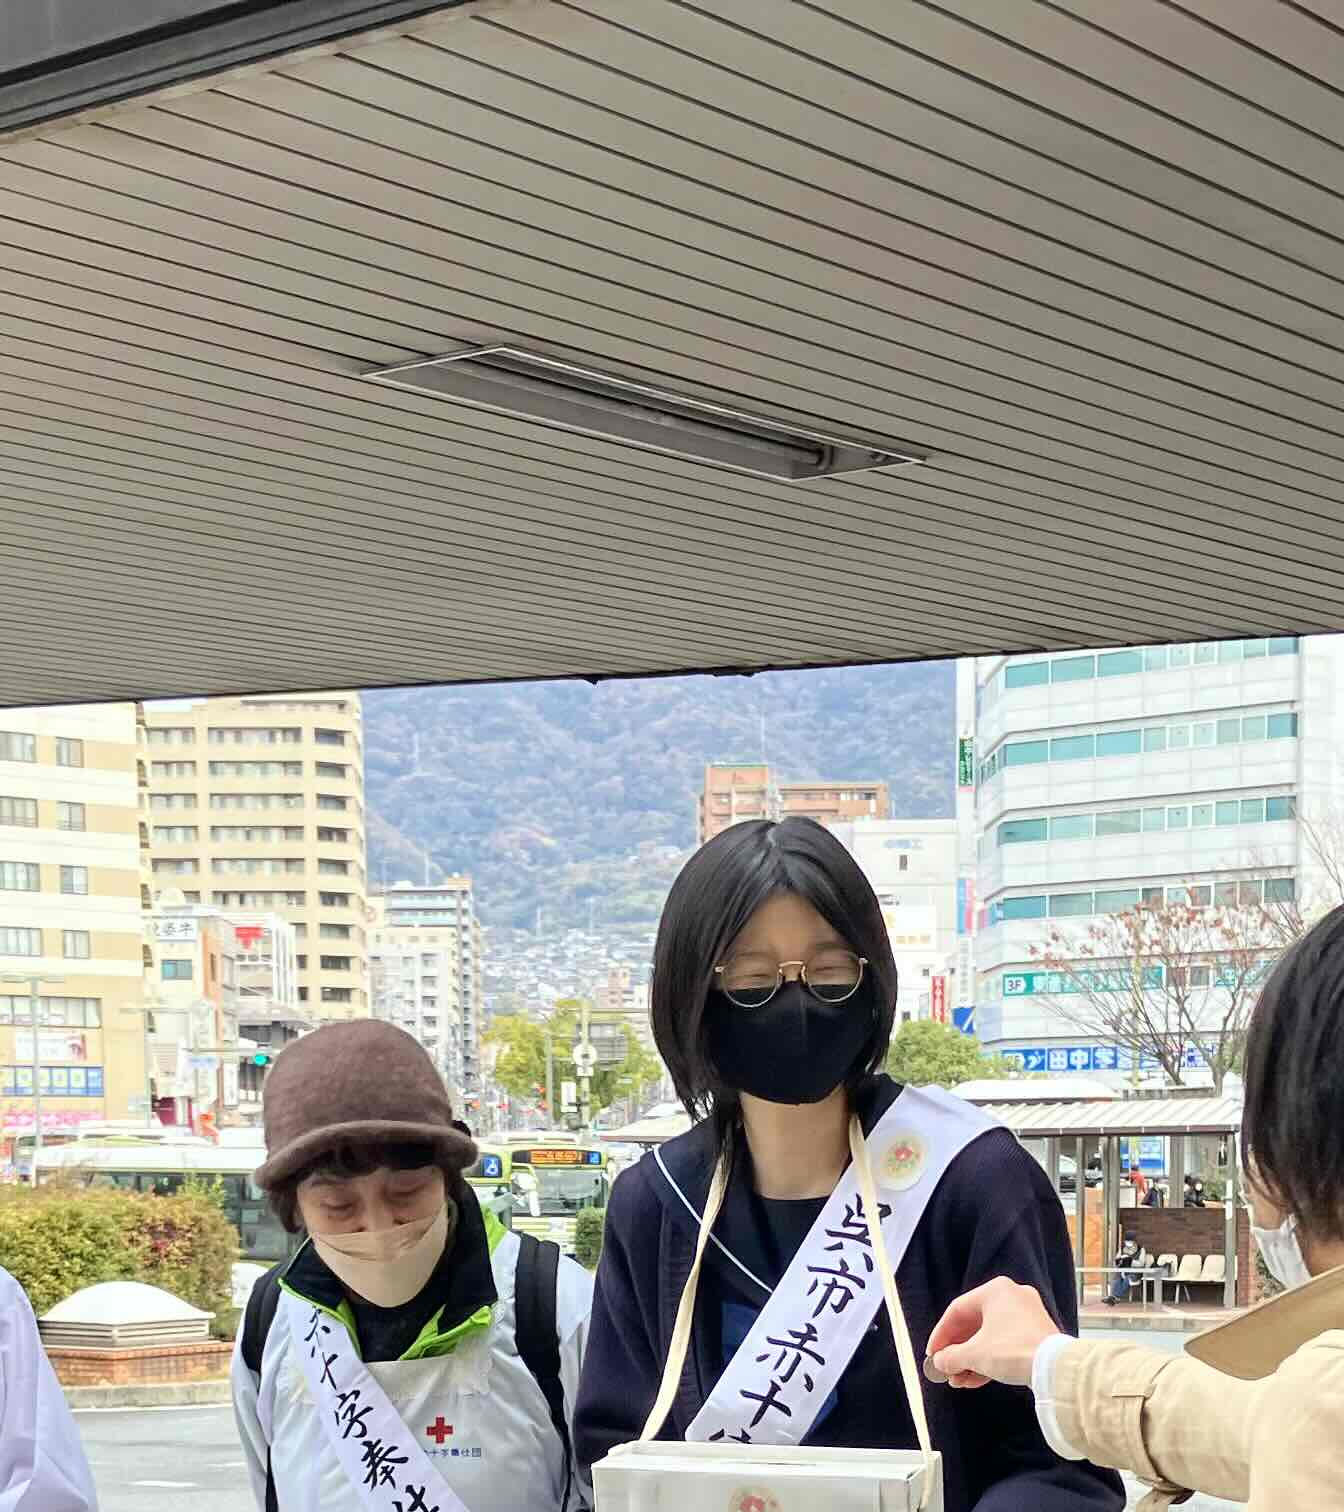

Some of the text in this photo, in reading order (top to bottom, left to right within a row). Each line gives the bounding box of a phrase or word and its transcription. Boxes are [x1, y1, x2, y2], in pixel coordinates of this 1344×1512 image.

[1007, 977, 1022, 991] 3F
[709, 1193, 893, 1445] 呉市赤十
